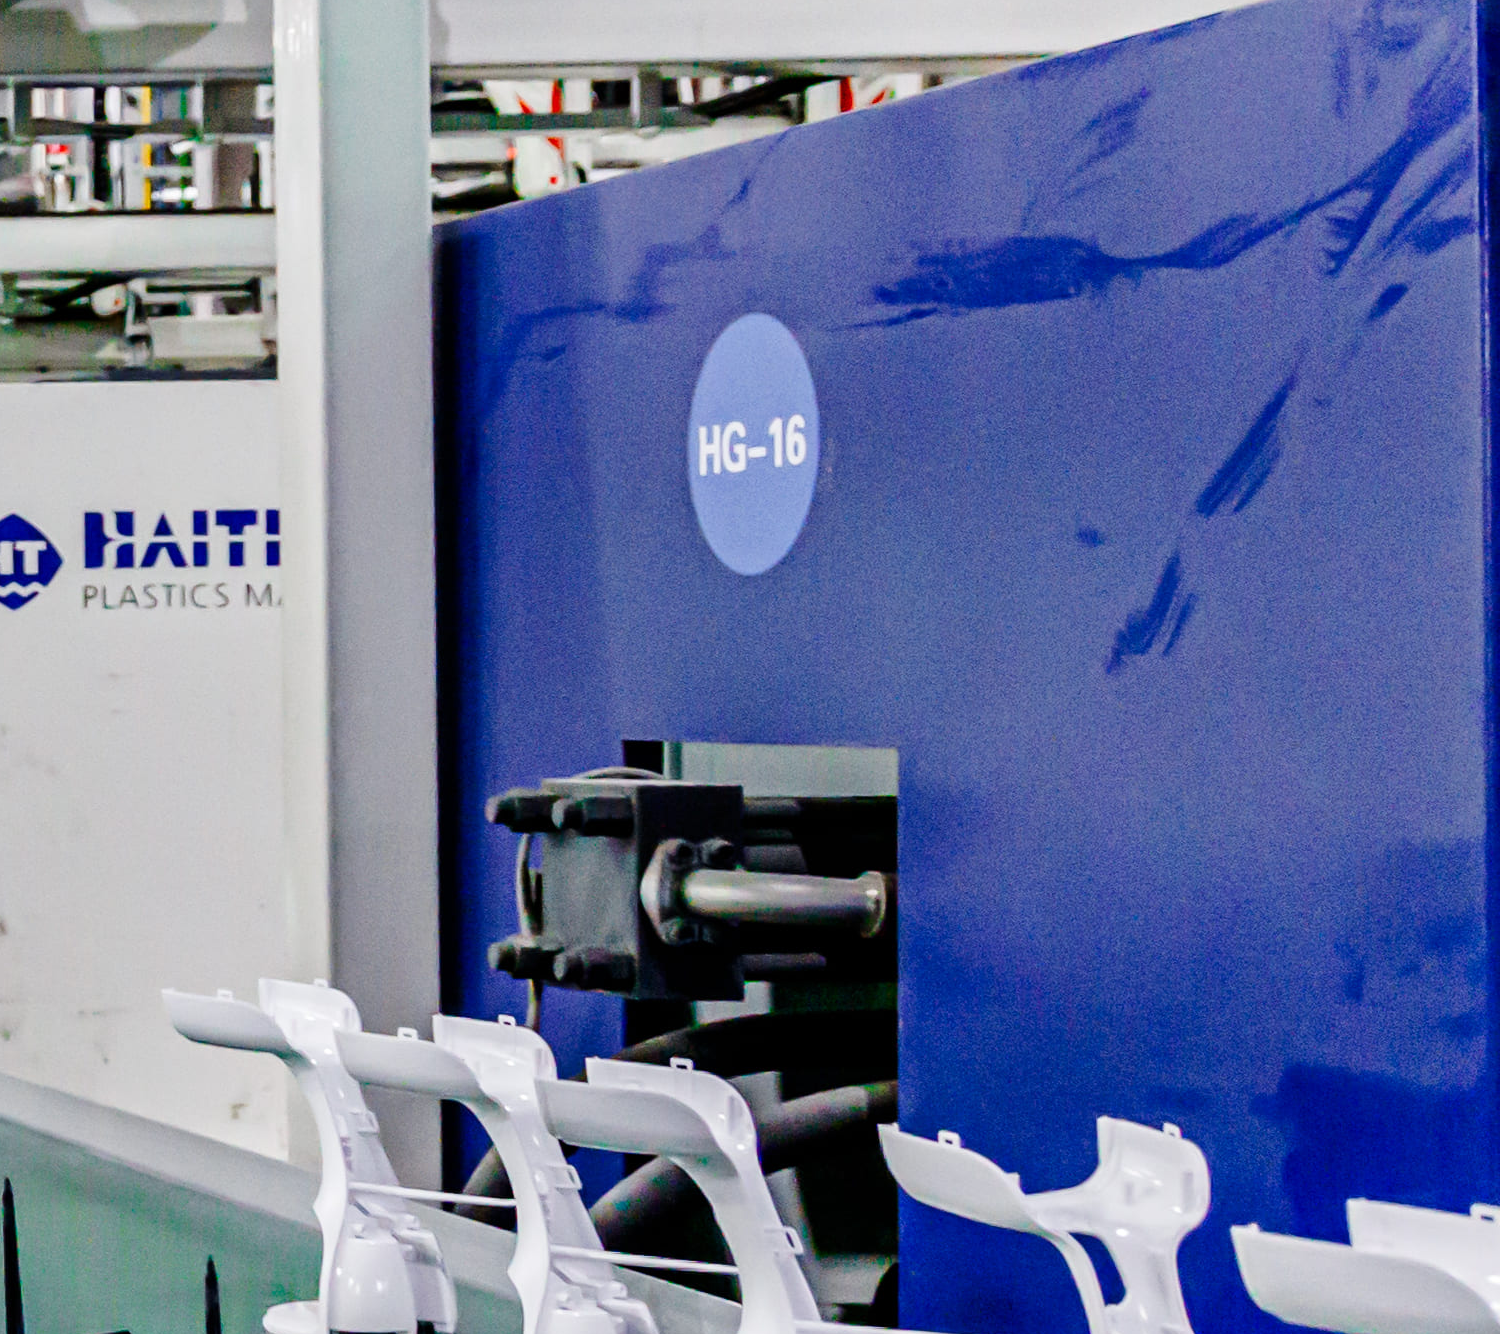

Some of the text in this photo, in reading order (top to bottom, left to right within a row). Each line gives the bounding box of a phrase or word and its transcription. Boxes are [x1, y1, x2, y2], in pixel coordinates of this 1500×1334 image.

[698, 414, 807, 476] HG-16
[83, 583, 283, 610] PLASTICS M
